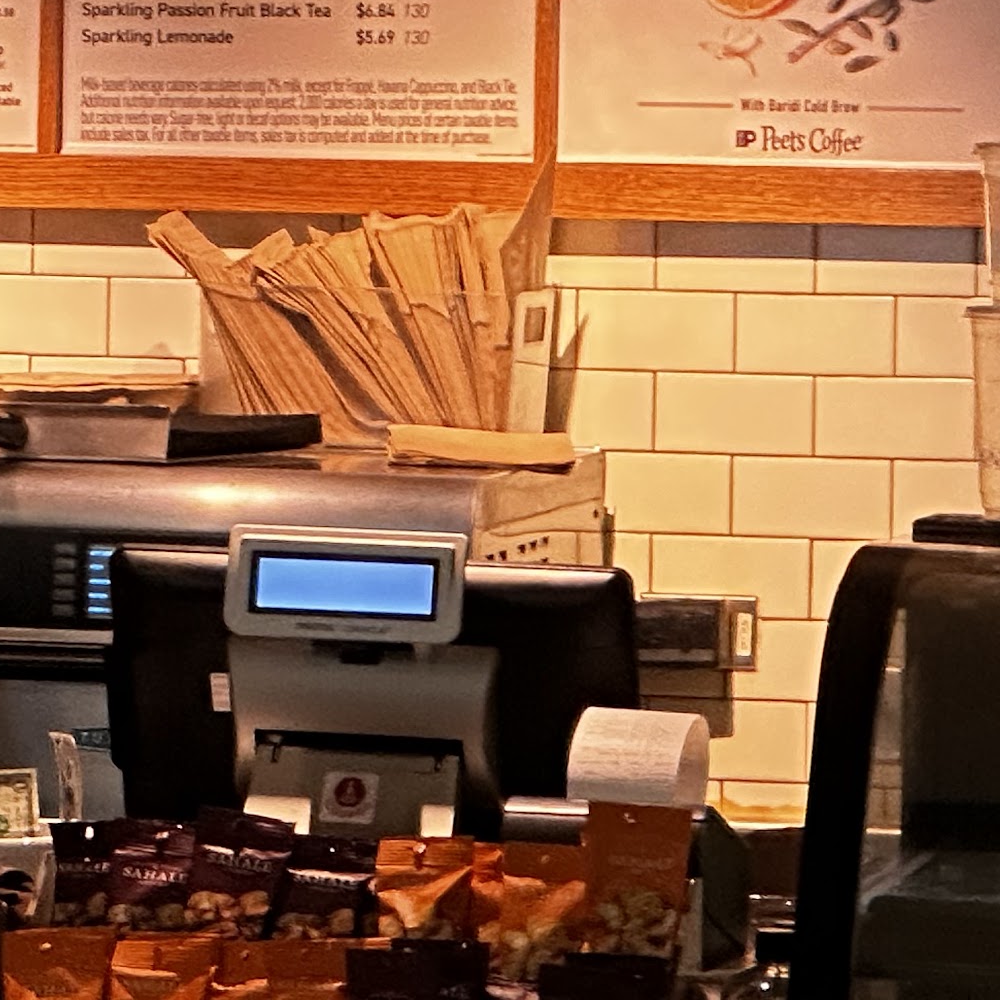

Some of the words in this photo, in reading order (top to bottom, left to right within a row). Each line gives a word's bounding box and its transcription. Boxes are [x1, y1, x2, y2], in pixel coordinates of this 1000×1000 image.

[81, 2, 153, 20] Sparkling
[158, 2, 214, 17] Passion
[220, 3, 255, 17] Fruit
[260, 3, 302, 18] Black
[305, 3, 332, 18] Tea
[356, 2, 395, 19] $6.84
[81, 29, 152, 46] Sparkling
[157, 29, 234, 43] Lemonade
[356, 29, 395, 46] $5.69
[740, 98, 765, 112] With
[804, 99, 828, 113] Cold
[831, 100, 860, 113] Brew
[809, 127, 864, 156] Coffee
